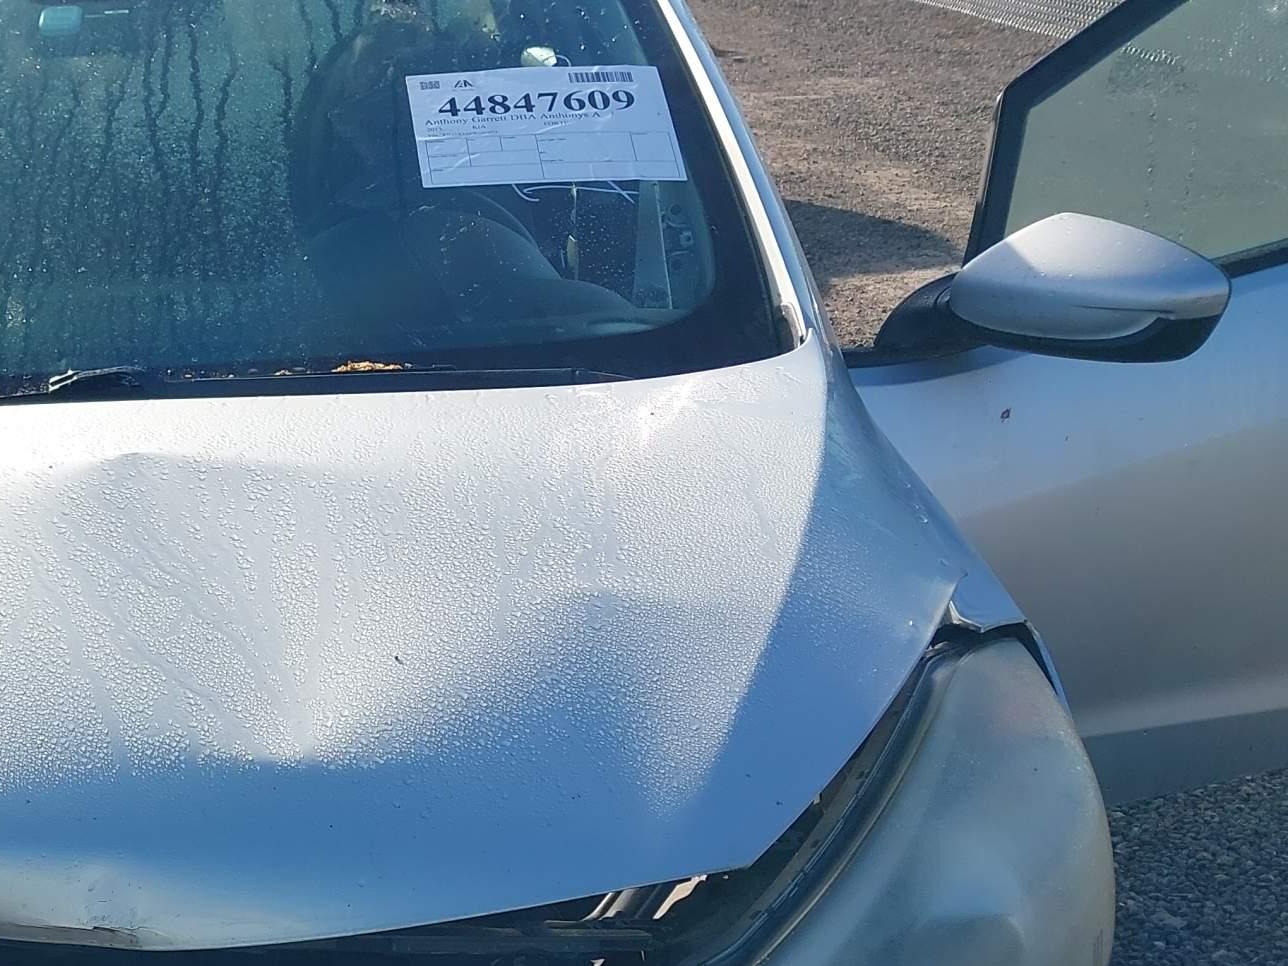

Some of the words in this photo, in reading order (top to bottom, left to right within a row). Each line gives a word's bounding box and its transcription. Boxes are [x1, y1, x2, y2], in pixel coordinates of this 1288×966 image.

[438, 89, 635, 117] 44847609
[425, 118, 469, 126] Anthony
[471, 115, 508, 124] Garrett
